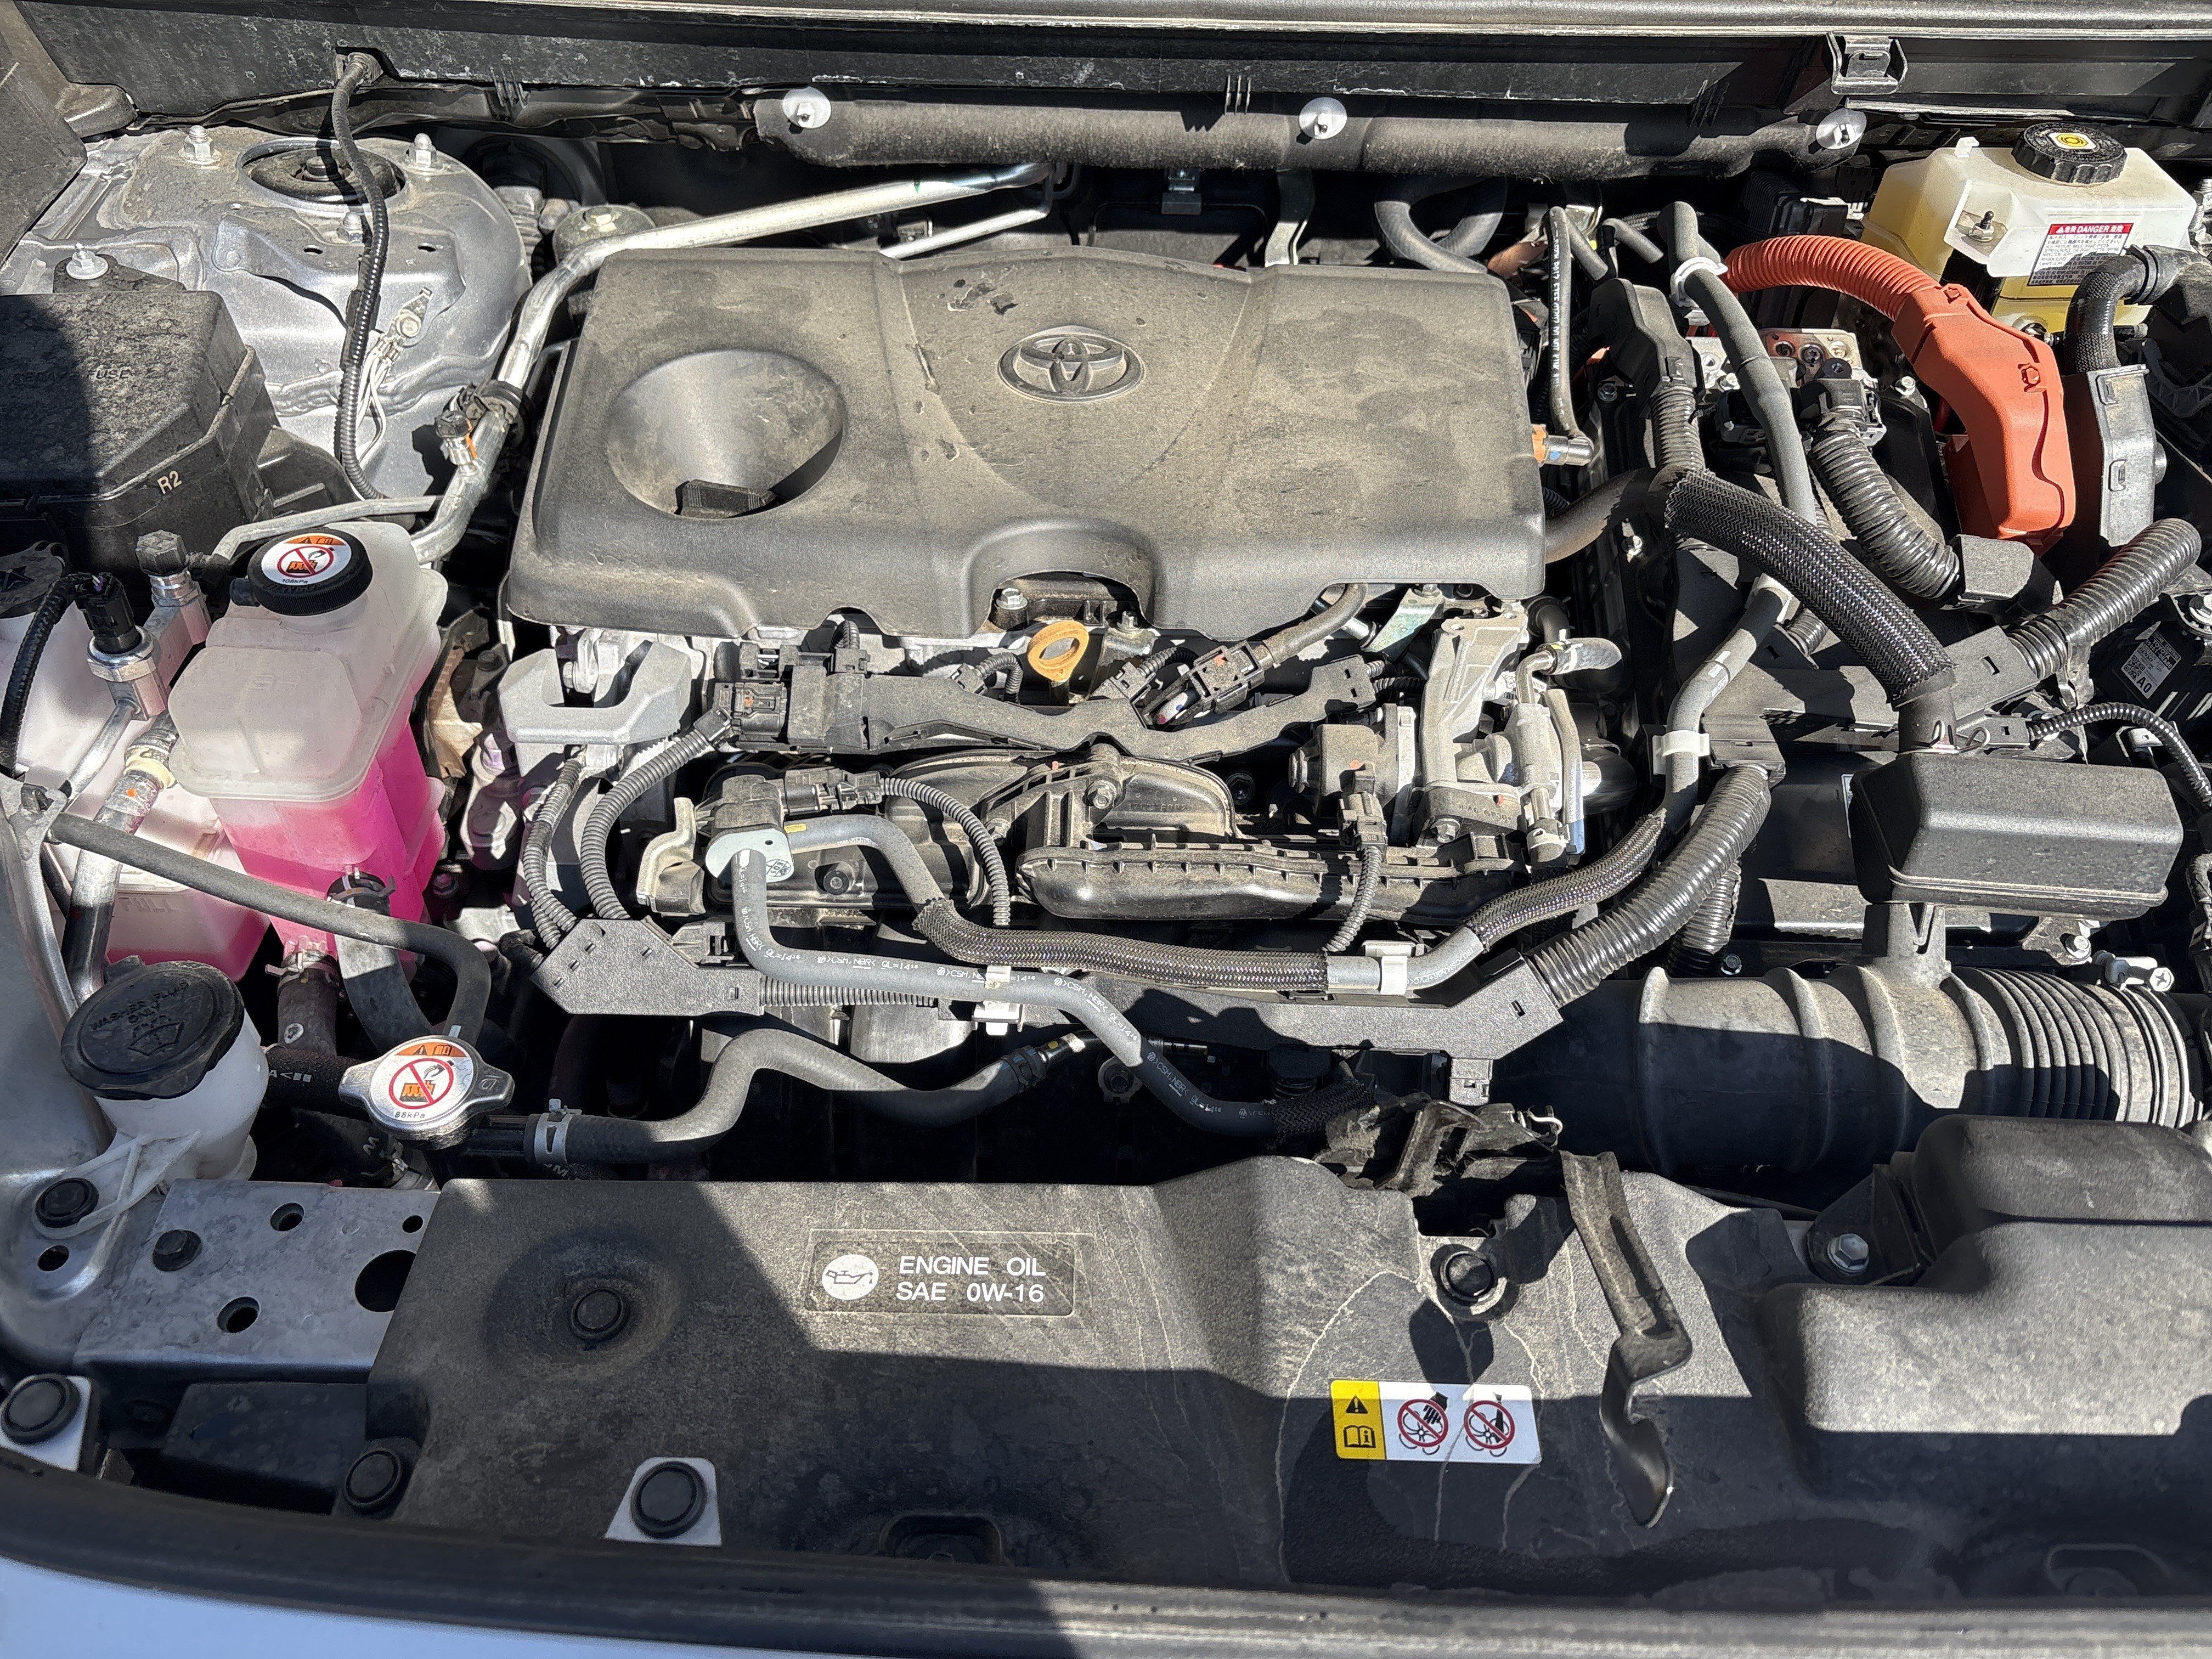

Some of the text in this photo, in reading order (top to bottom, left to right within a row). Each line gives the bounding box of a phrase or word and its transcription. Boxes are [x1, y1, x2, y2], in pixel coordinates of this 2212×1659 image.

[157, 470, 182, 494] R2
[2152, 639, 2170, 661] TOYOTA
[91, 1001, 146, 1030] WASHER
[128, 1003, 161, 1023] ONLY
[899, 1256, 1046, 1276] ENGINE OIL
[896, 1281, 1045, 1303] SAE 0W-16
